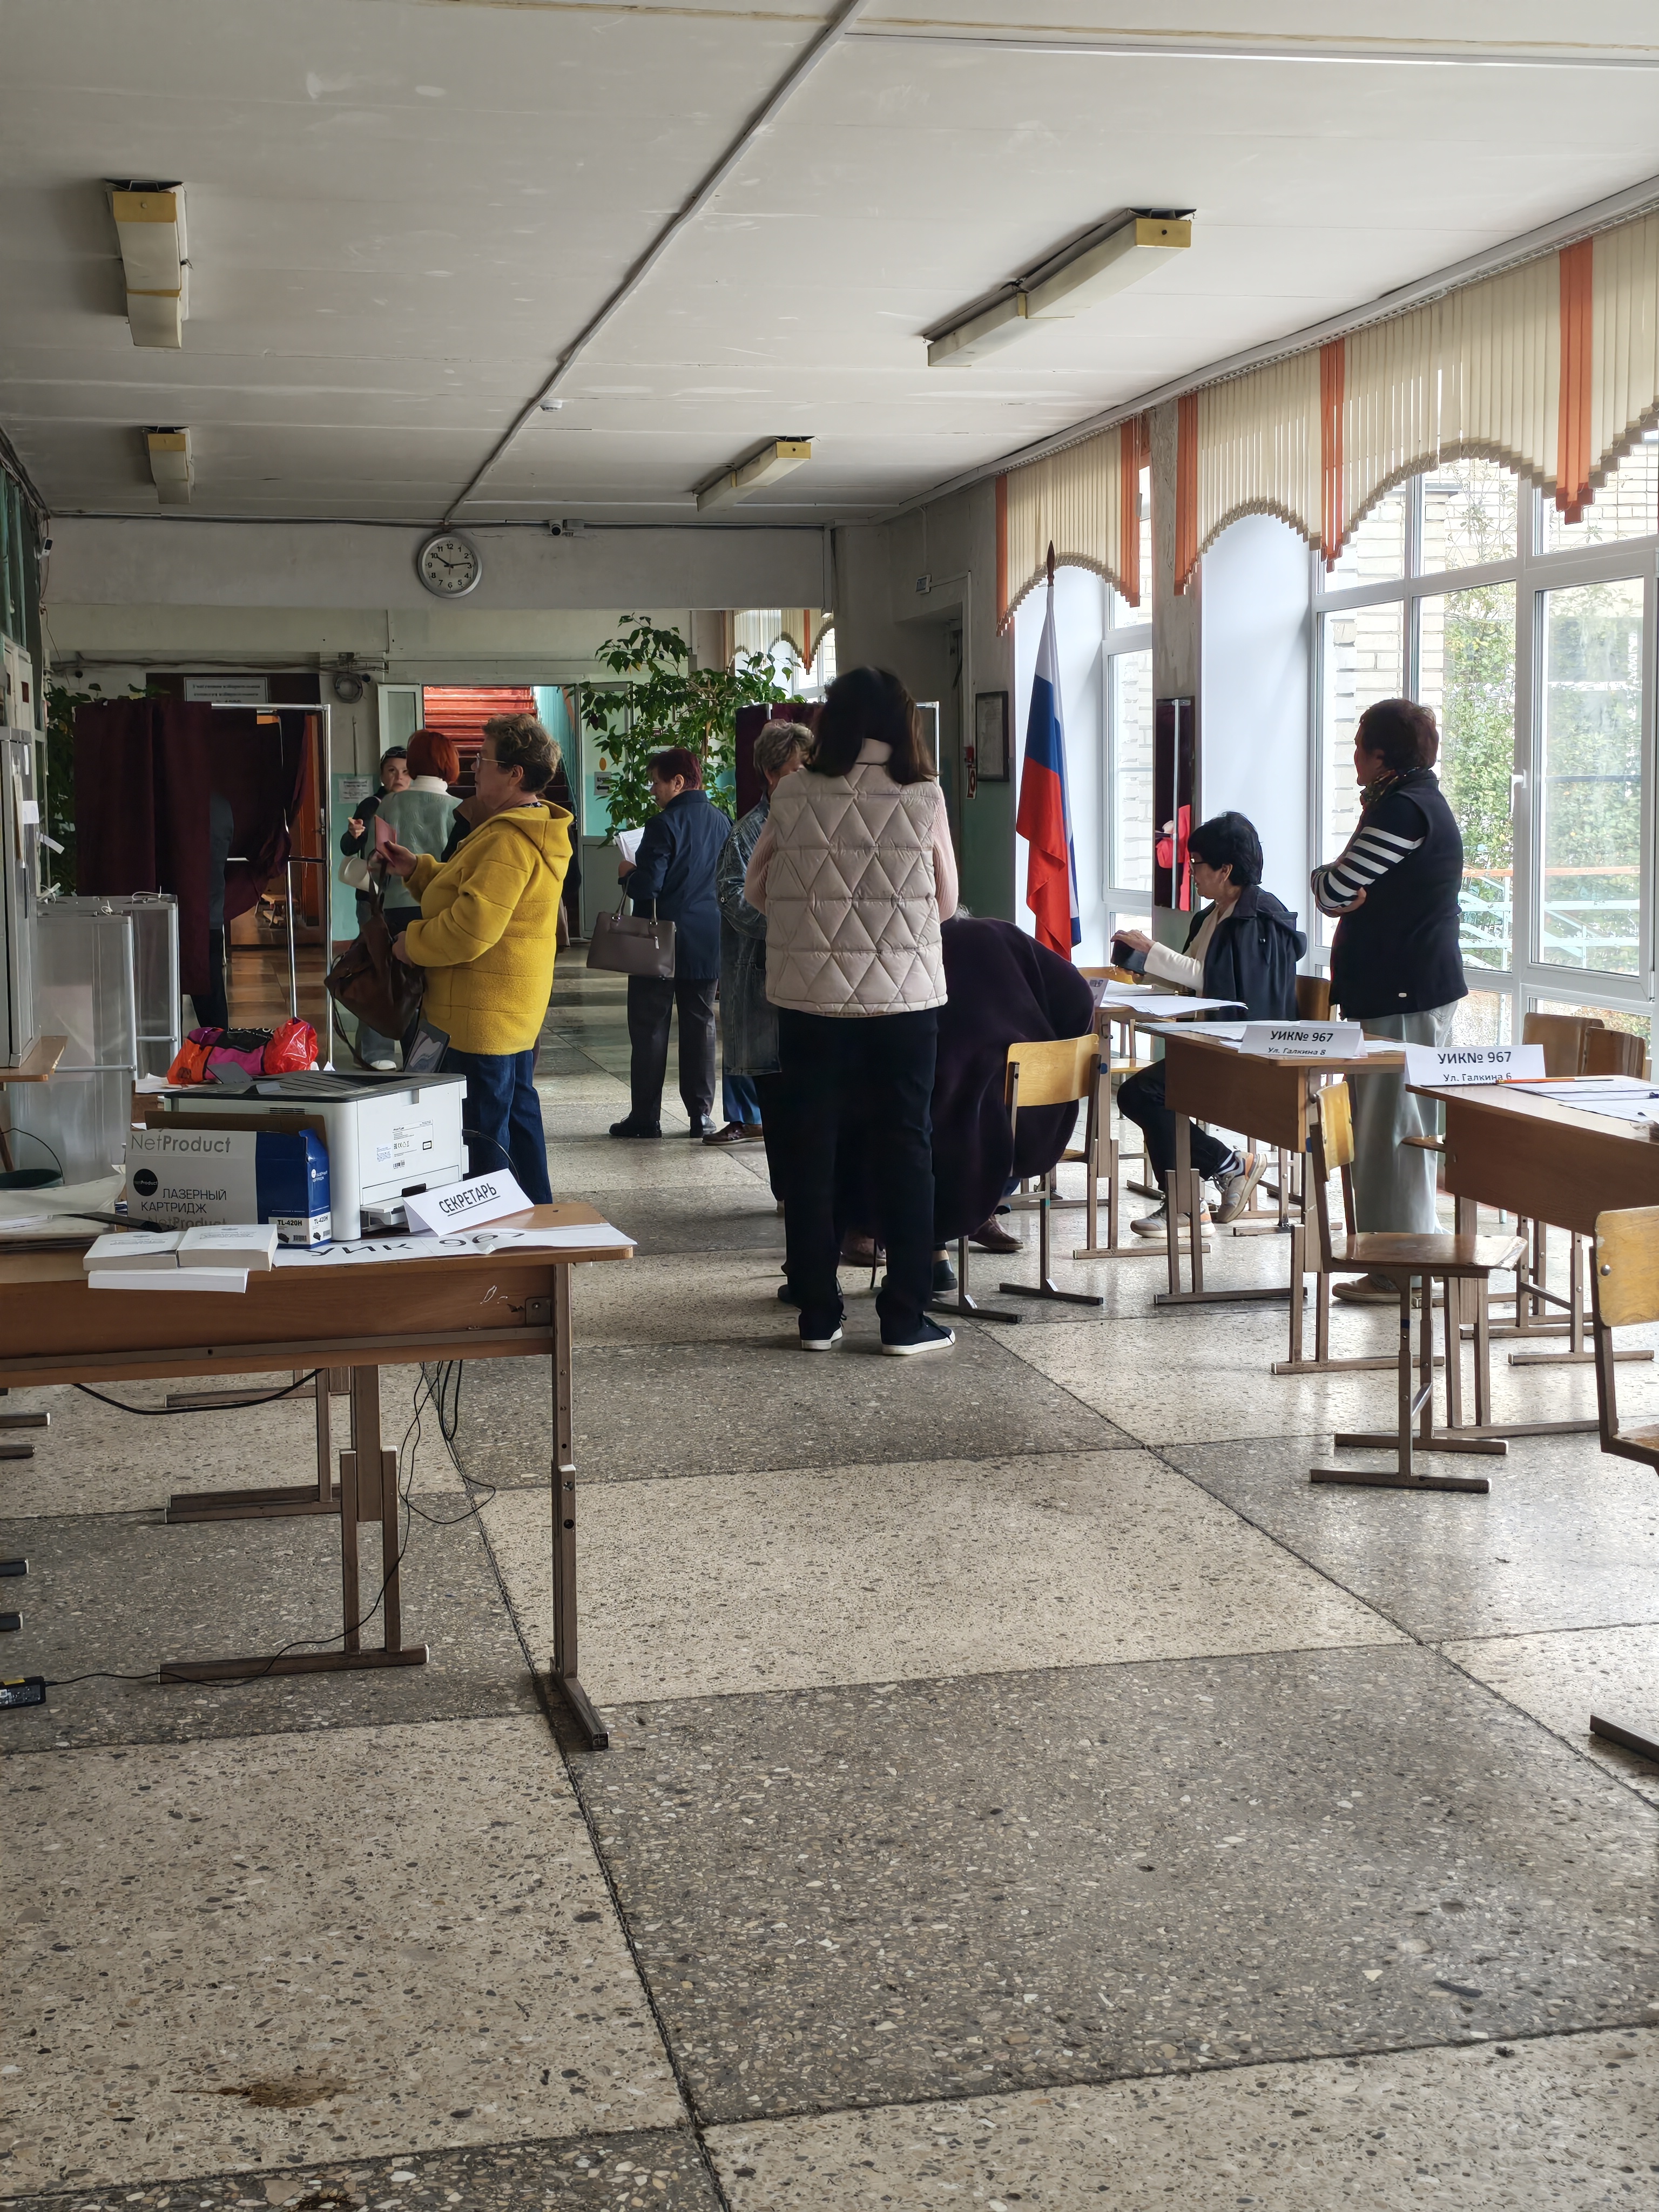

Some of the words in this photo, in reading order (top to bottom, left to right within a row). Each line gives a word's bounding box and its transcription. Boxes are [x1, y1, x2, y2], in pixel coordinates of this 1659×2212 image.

[1312, 1033, 1333, 1042] 967
[1487, 1052, 1512, 1062] 967
[131, 1134, 231, 1153] NetProduct
[163, 1188, 227, 1201] ЛАЗЕРНЫЙ
[439, 1183, 497, 1213] СЕКРЕТАРЬ
[141, 1202, 207, 1214] КАРТРИДЖ
[148, 1216, 227, 1229] etProd
[304, 1243, 414, 1257] УИК
